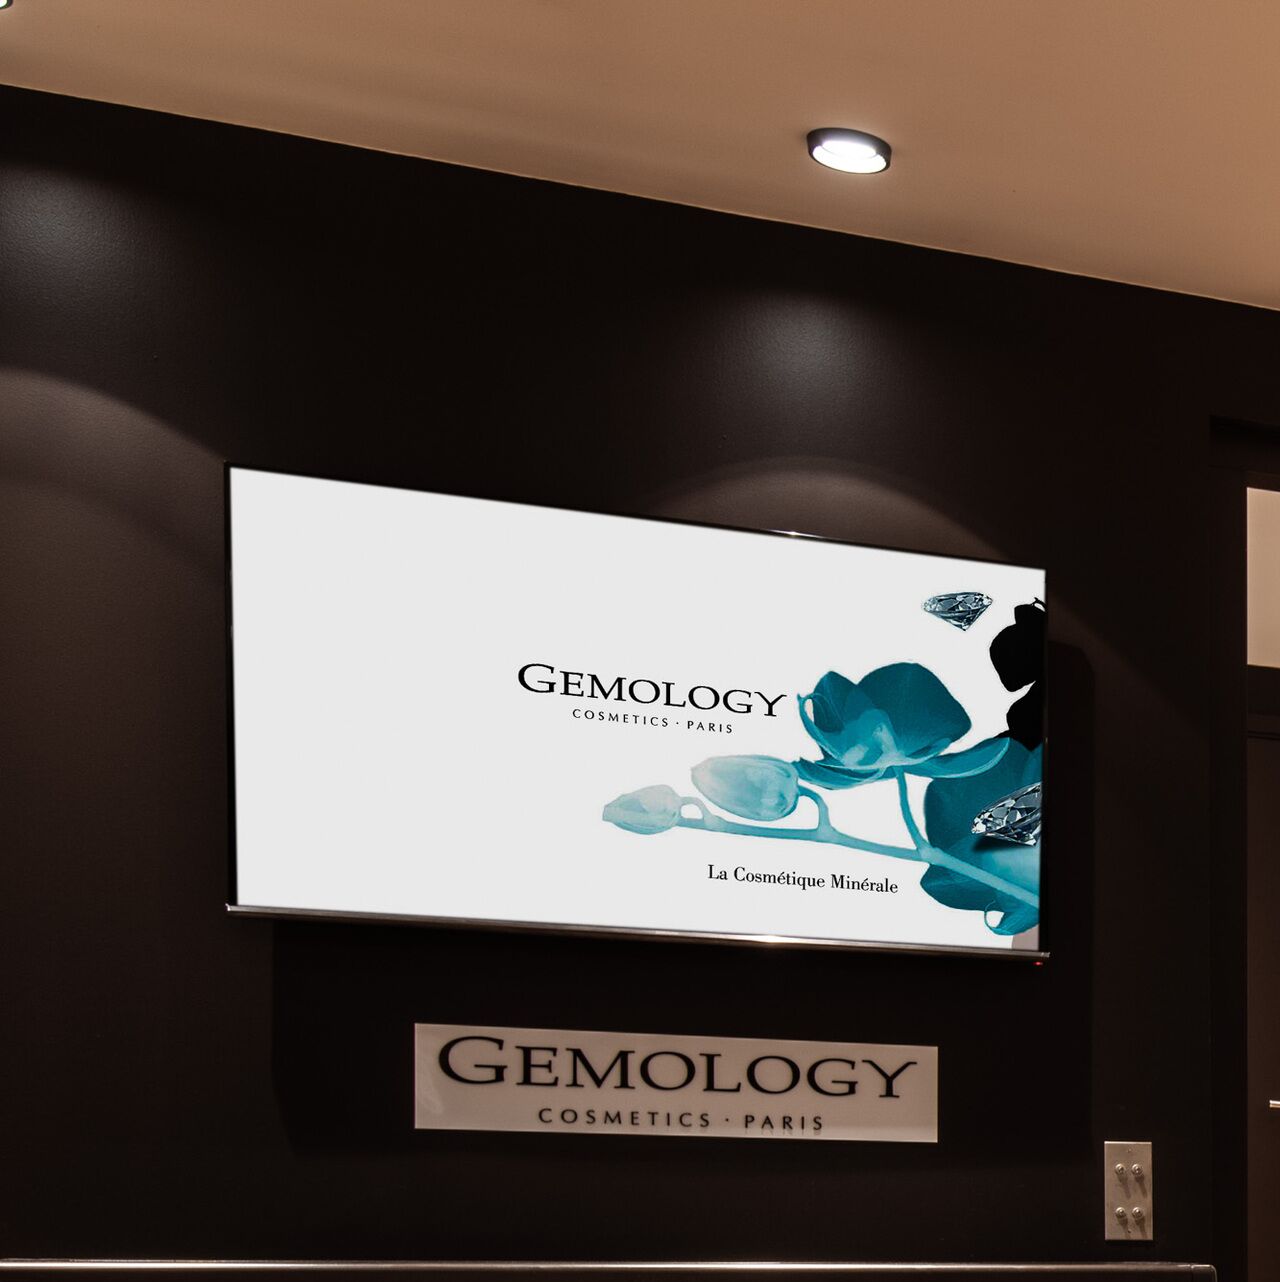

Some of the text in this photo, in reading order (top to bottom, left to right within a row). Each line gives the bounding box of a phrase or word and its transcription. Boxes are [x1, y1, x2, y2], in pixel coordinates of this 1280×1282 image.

[517, 663, 787, 717] GEMOLOGY
[572, 708, 733, 734] COSMETICS PARIS
[707, 864, 899, 893] La Cosmétique Minérale
[437, 1035, 917, 1099] GEMOLOGY
[538, 1107, 824, 1131] COSMETICS PARIS
